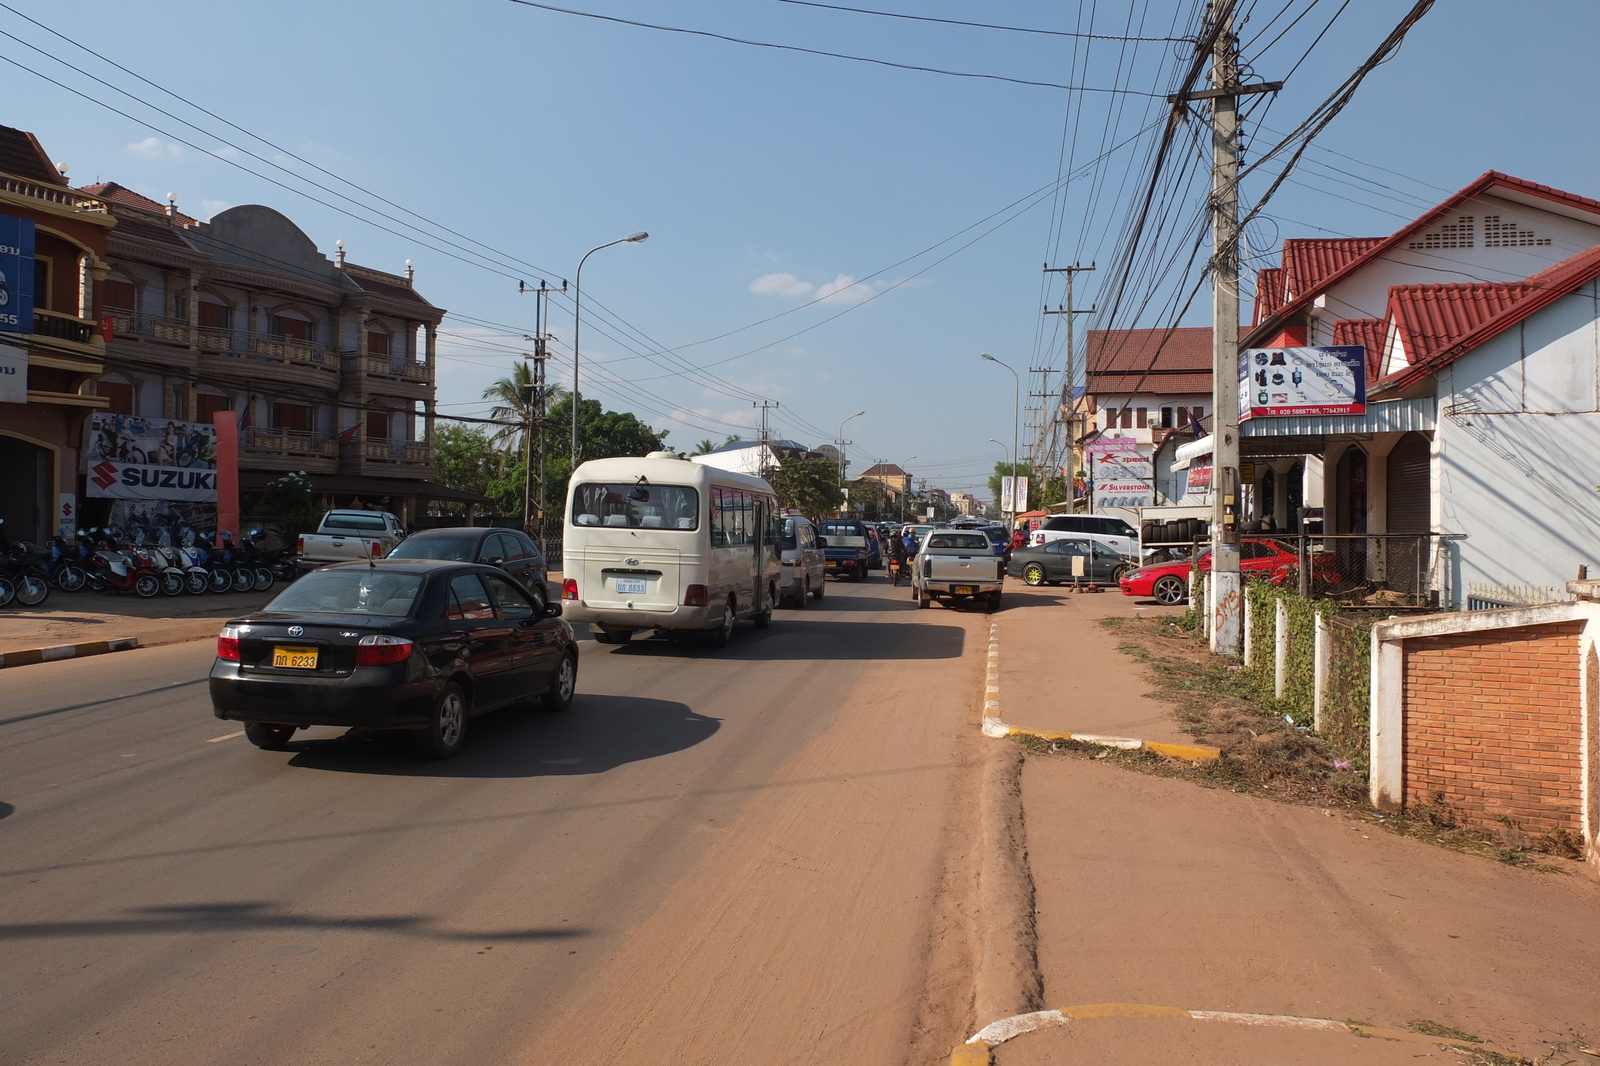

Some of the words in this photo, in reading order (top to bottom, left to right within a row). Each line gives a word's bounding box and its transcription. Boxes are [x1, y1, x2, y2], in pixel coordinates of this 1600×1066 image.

[1279, 407, 1291, 415] 020
[628, 584, 645, 592] 8833
[291, 655, 315, 667] 6233
